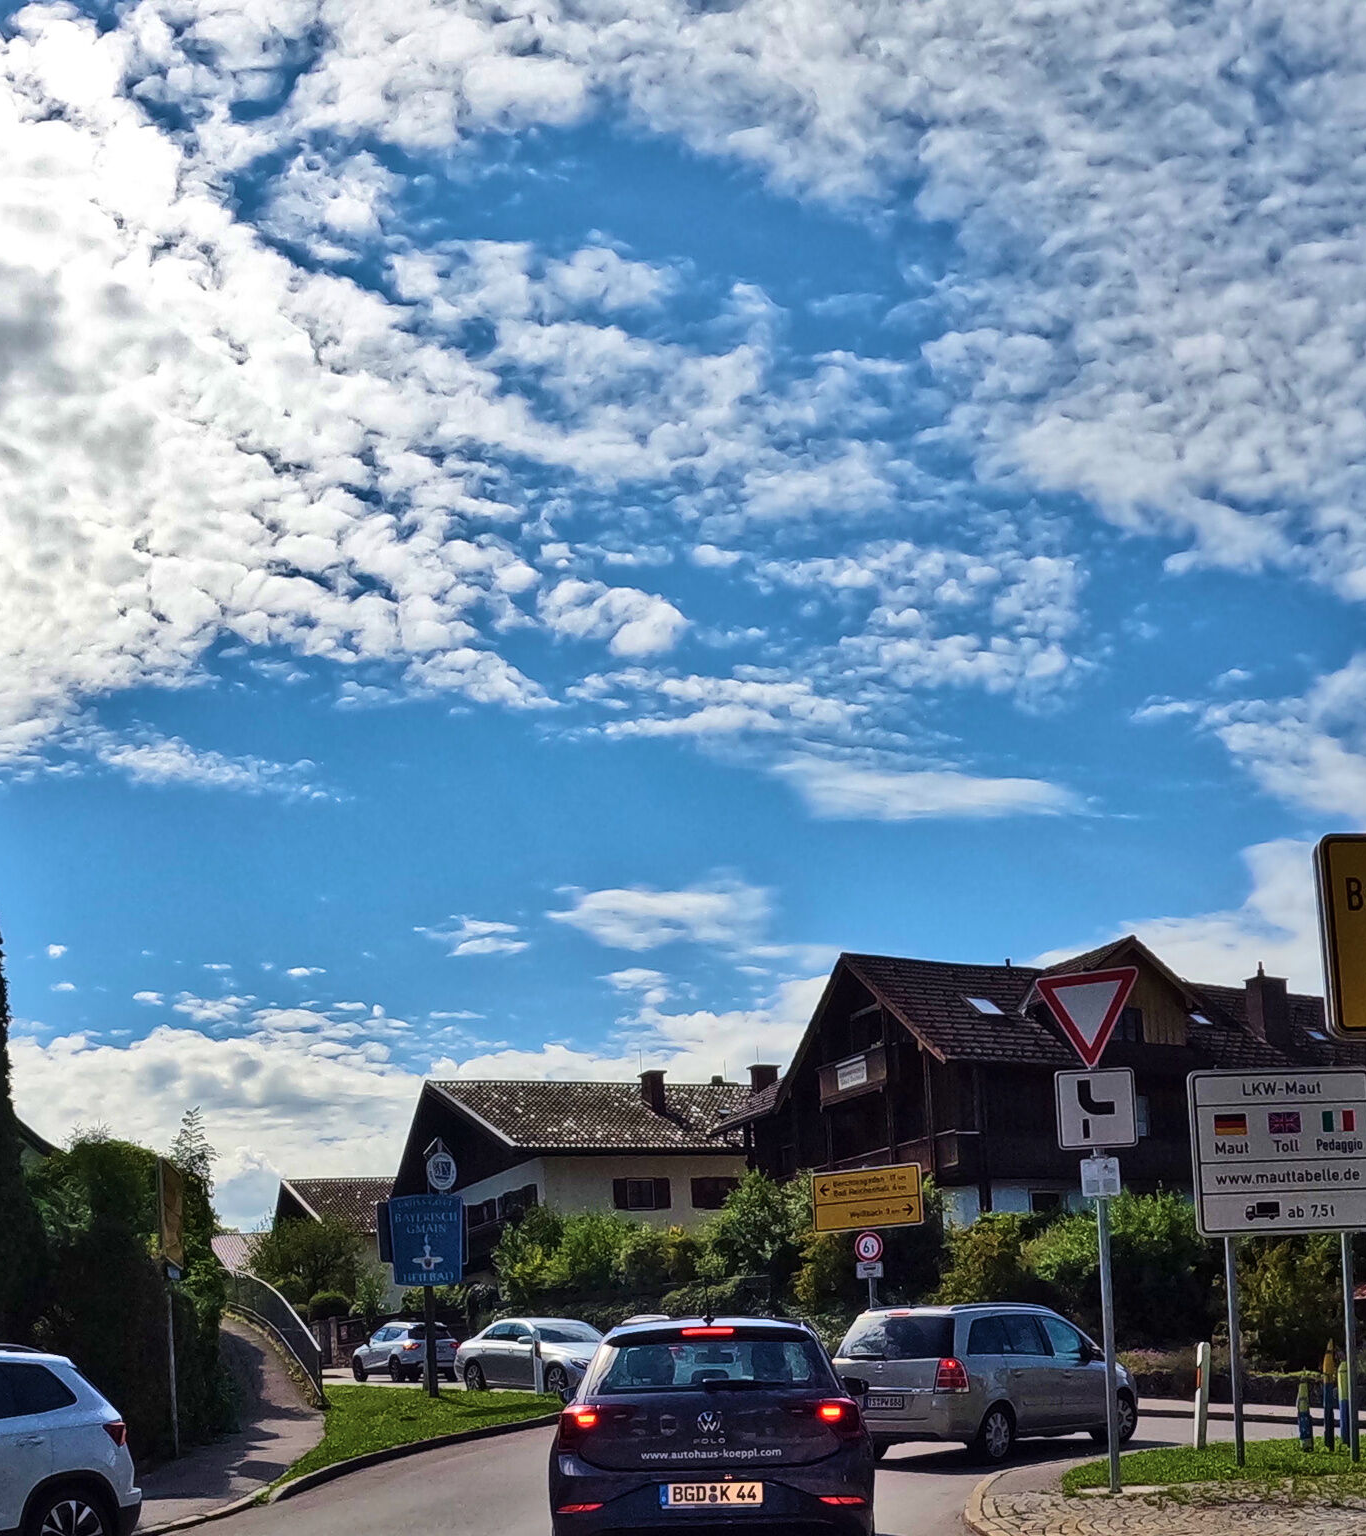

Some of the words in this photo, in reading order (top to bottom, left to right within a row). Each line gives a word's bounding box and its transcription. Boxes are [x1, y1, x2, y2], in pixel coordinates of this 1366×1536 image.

[1241, 1081, 1322, 1096] LKW-Maut
[1214, 1141, 1250, 1155] Maut
[1273, 1139, 1300, 1153] Toll
[1316, 1138, 1363, 1154] Pedaggio
[1215, 1168, 1360, 1185] www.mauttabelle.de
[1287, 1206, 1305, 1218] ab
[640, 1448, 783, 1460] www.autohaus-koeppl.com
[736, 1485, 757, 1501] 44
